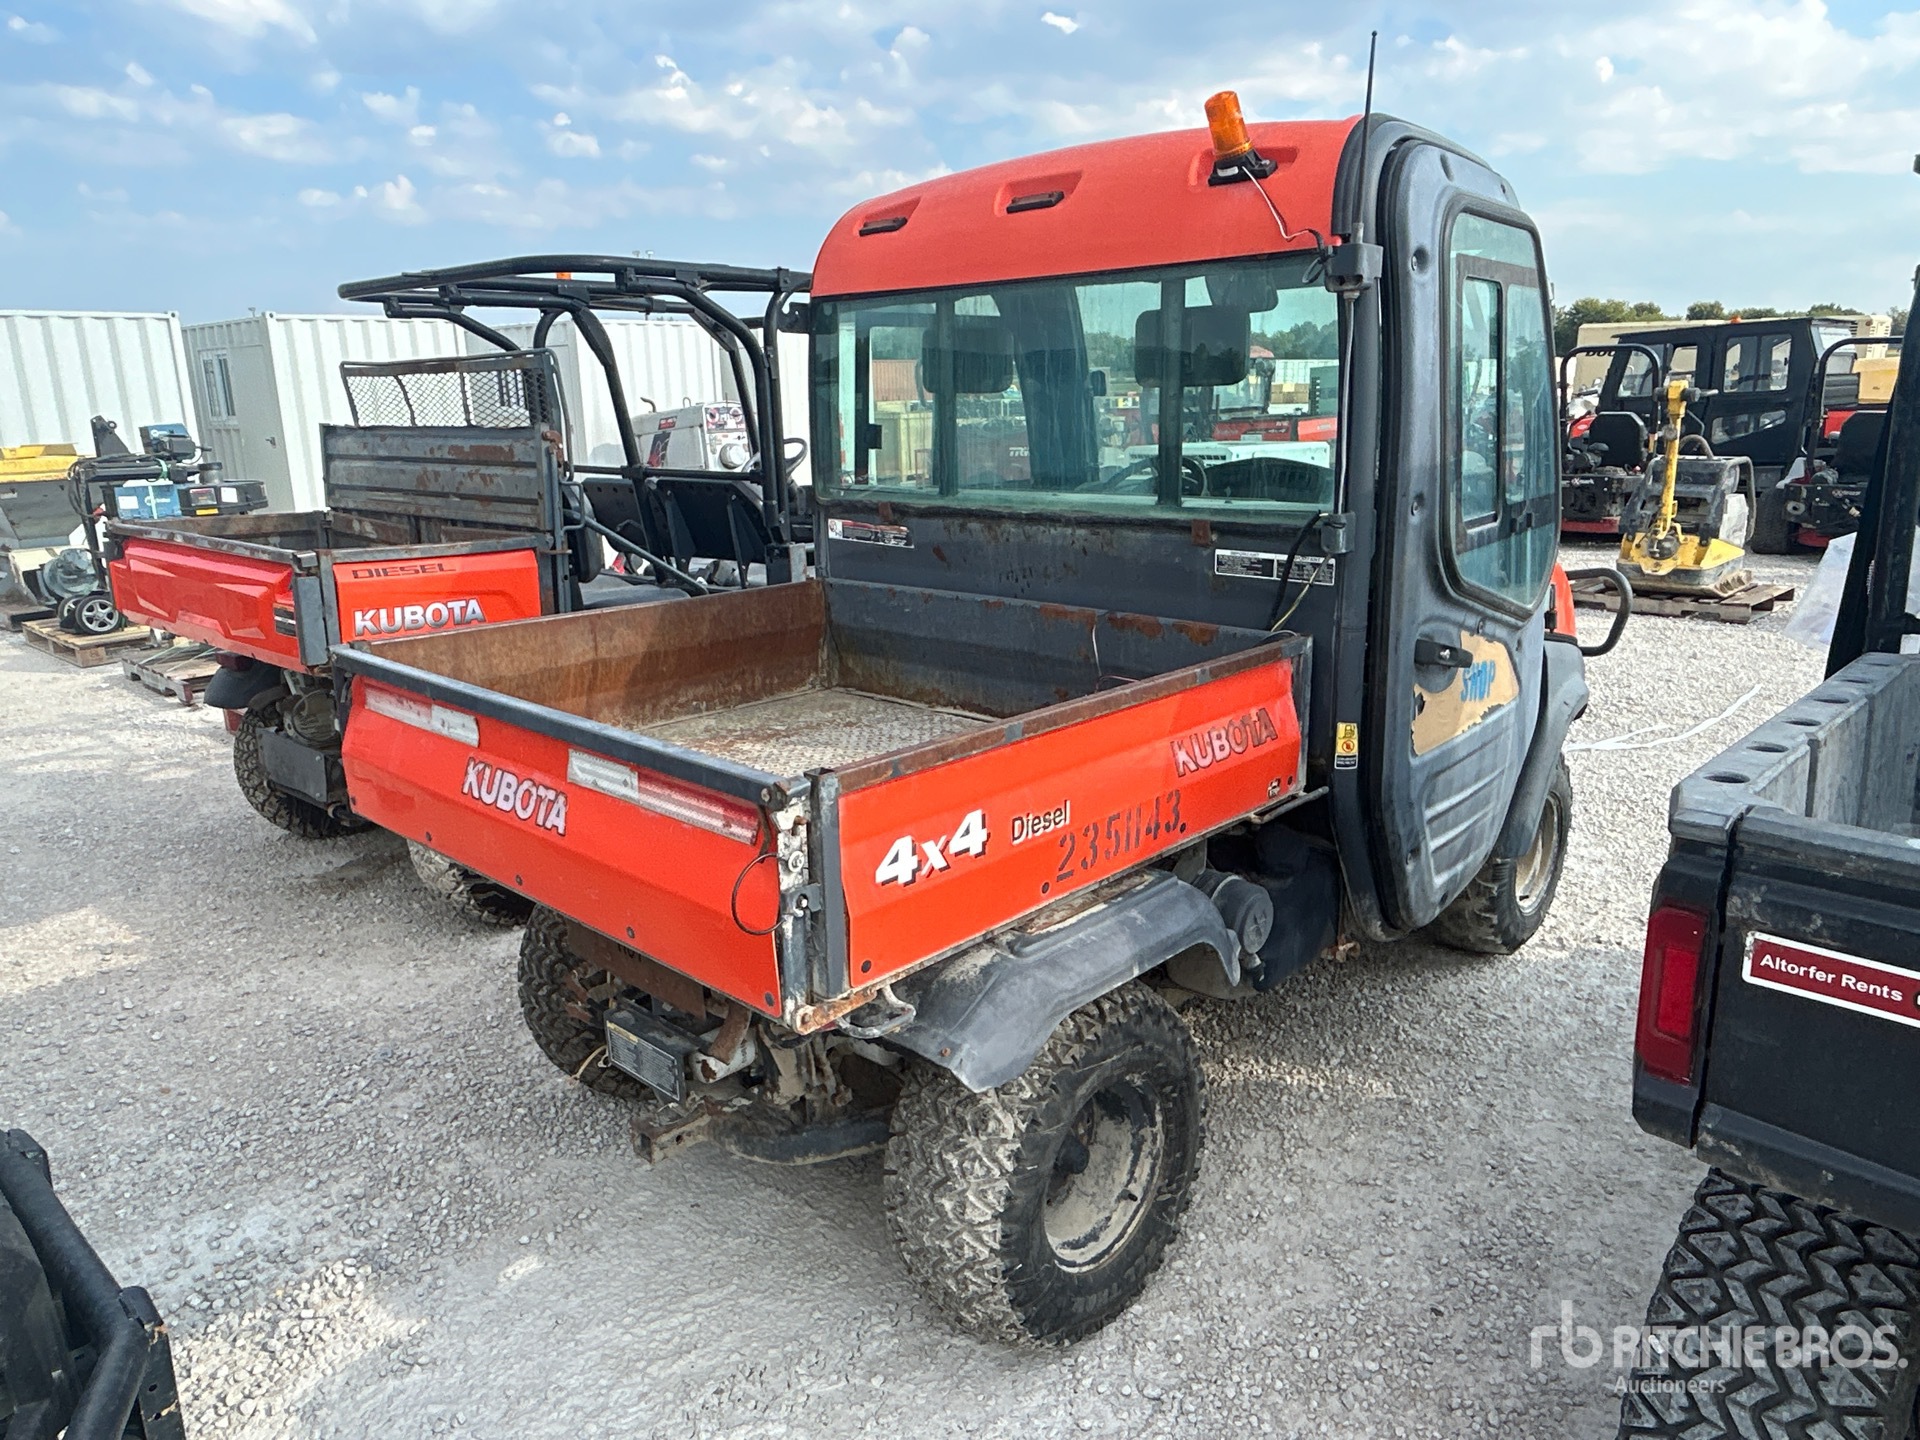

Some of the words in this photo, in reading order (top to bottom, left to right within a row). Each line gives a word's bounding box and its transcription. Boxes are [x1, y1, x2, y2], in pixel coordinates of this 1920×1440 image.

[352, 563, 456, 579] DIESEL
[354, 599, 486, 636] KUBOTA
[1170, 708, 1278, 777] KUBOTA
[462, 757, 568, 837] KUBOTA
[875, 809, 991, 887] 4x4
[1011, 799, 1071, 845] Diesel
[1760, 954, 1836, 984] Altorfer
[1841, 974, 1903, 1002] Rents
